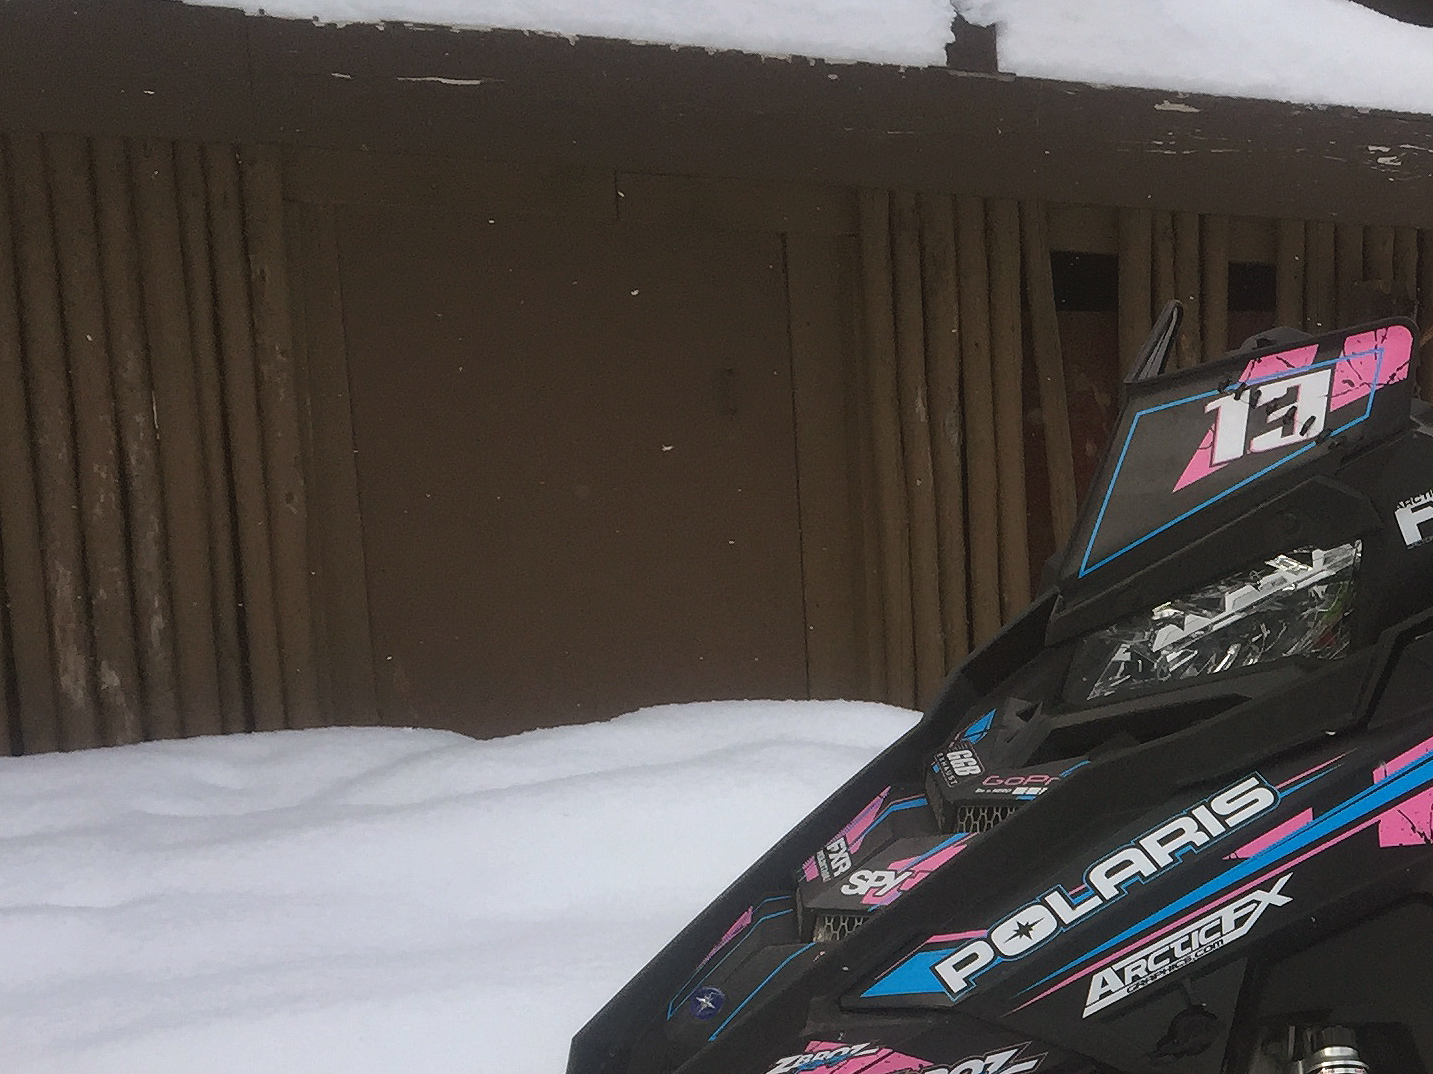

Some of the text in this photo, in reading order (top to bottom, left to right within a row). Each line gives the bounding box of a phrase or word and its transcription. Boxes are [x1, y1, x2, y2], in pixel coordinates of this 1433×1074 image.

[1204, 369, 1332, 466] 13
[982, 775, 1060, 786] GoPr
[826, 837, 852, 878] FXR
[841, 869, 913, 896] SPY
[935, 776, 1276, 994] POLARIS
